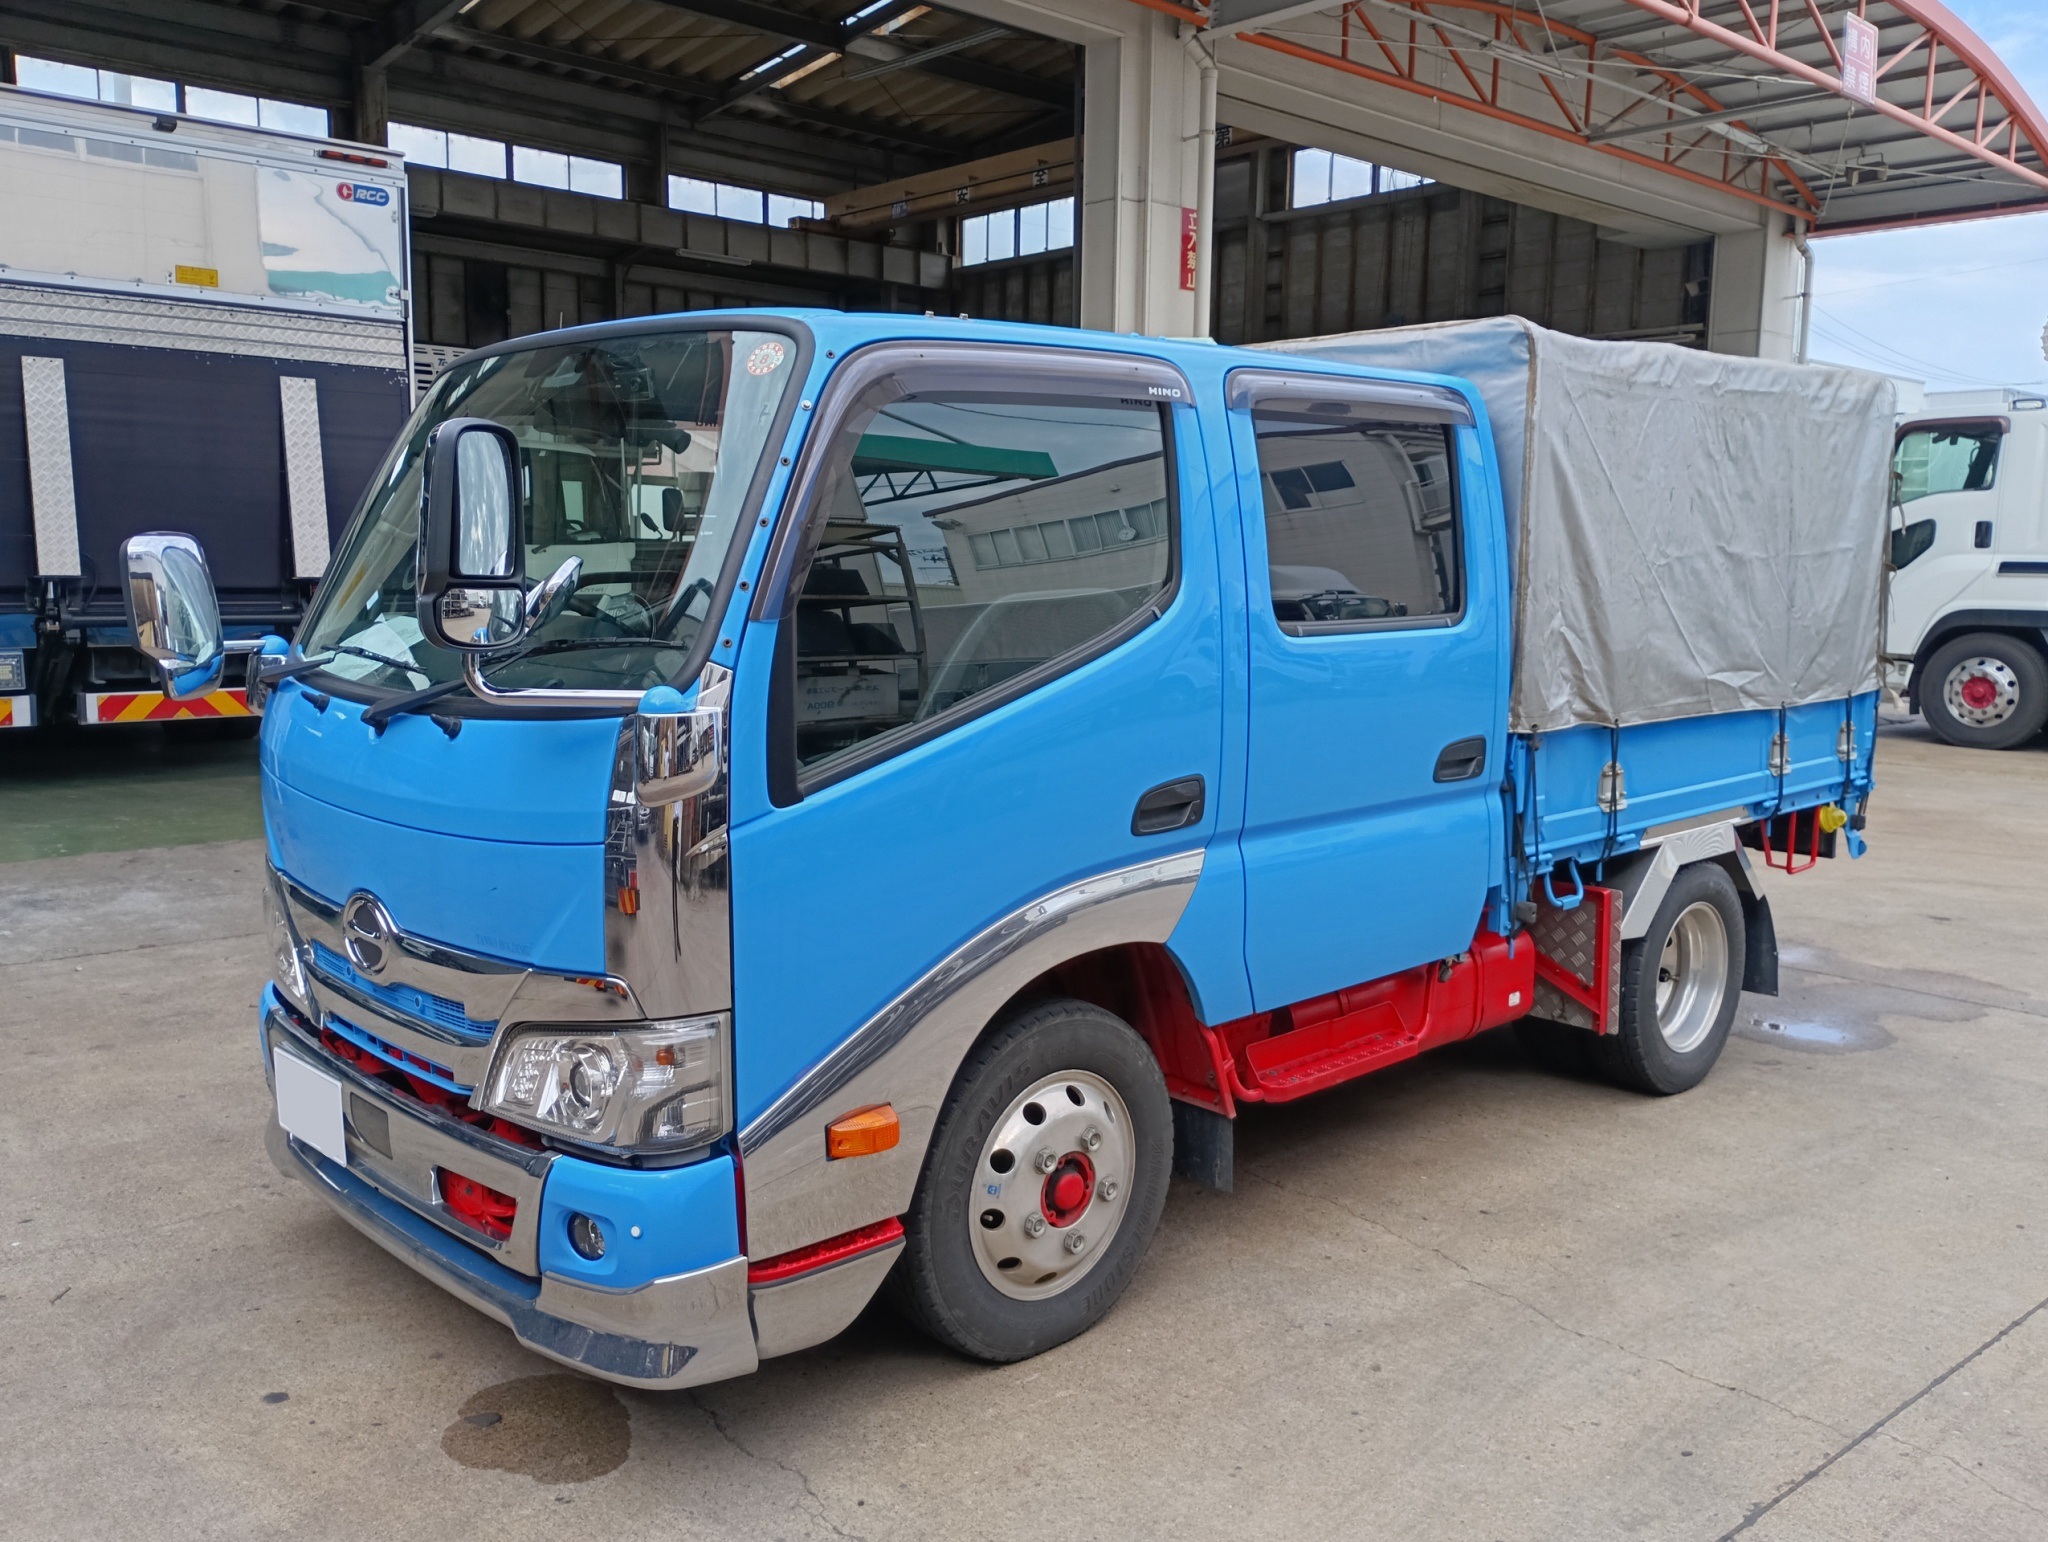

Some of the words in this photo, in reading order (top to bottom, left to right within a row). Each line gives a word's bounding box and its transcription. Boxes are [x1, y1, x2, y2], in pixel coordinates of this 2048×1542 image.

[1848, 27, 1870, 60] 構内
[1845, 64, 1869, 97] 禁煙
[759, 353, 770, 365] 8
[1148, 386, 1181, 398] HINO
[947, 1058, 1032, 1222] DURAVIS
